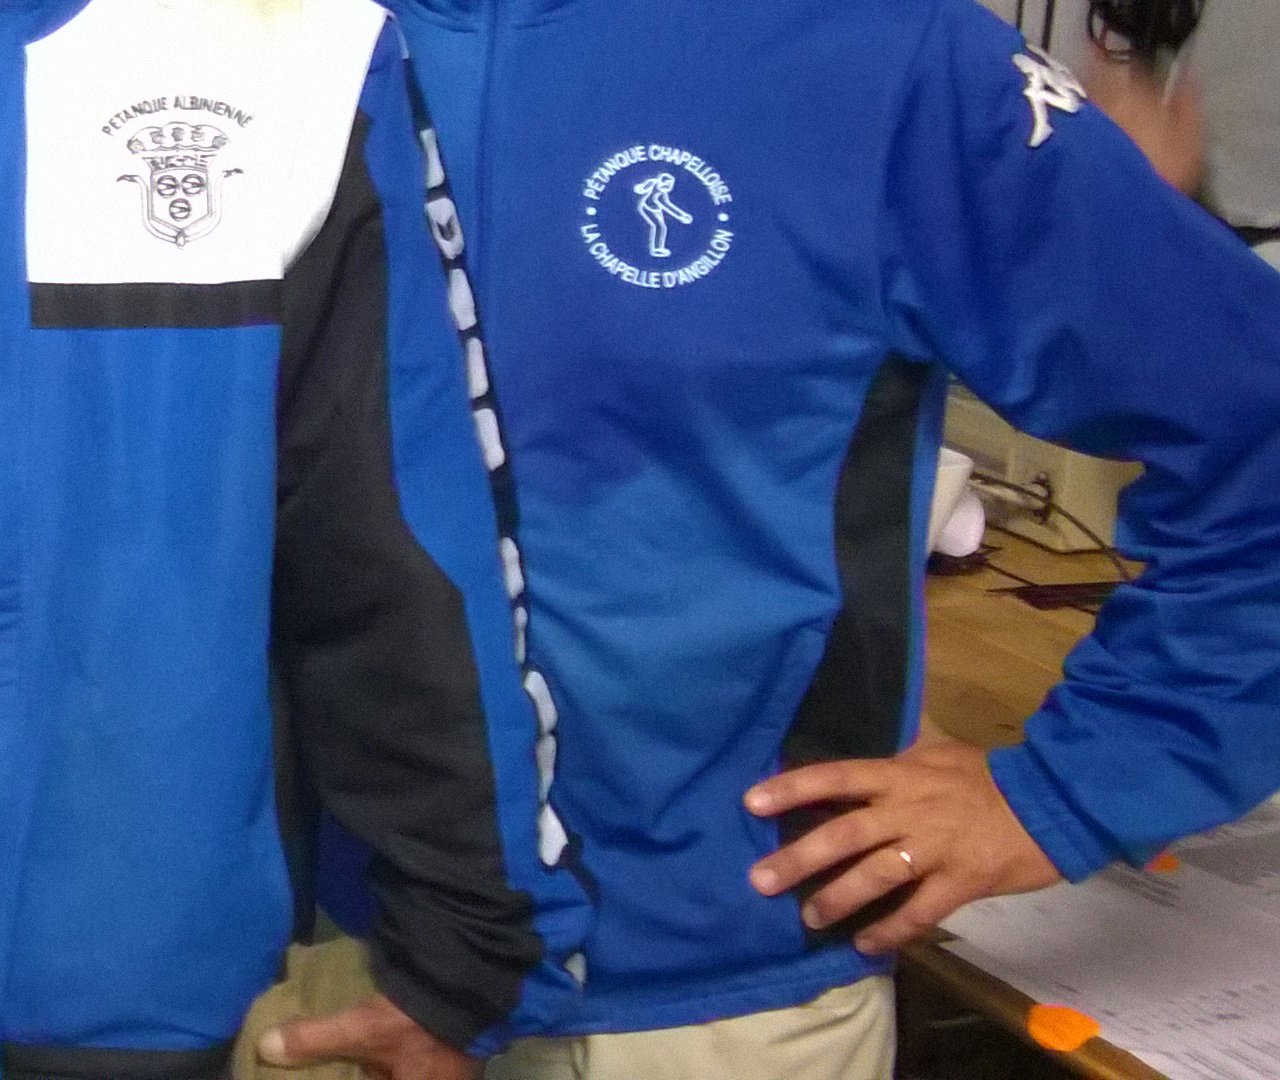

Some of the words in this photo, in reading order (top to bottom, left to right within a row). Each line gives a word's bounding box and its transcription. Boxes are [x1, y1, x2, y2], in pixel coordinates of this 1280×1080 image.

[582, 145, 648, 201] PÉTANQUE
[648, 144, 733, 206] CHAPELLOISE
[580, 223, 602, 244] LA
[661, 228, 735, 289] D'ANGILLON
[589, 242, 661, 289] CHAPELLE
